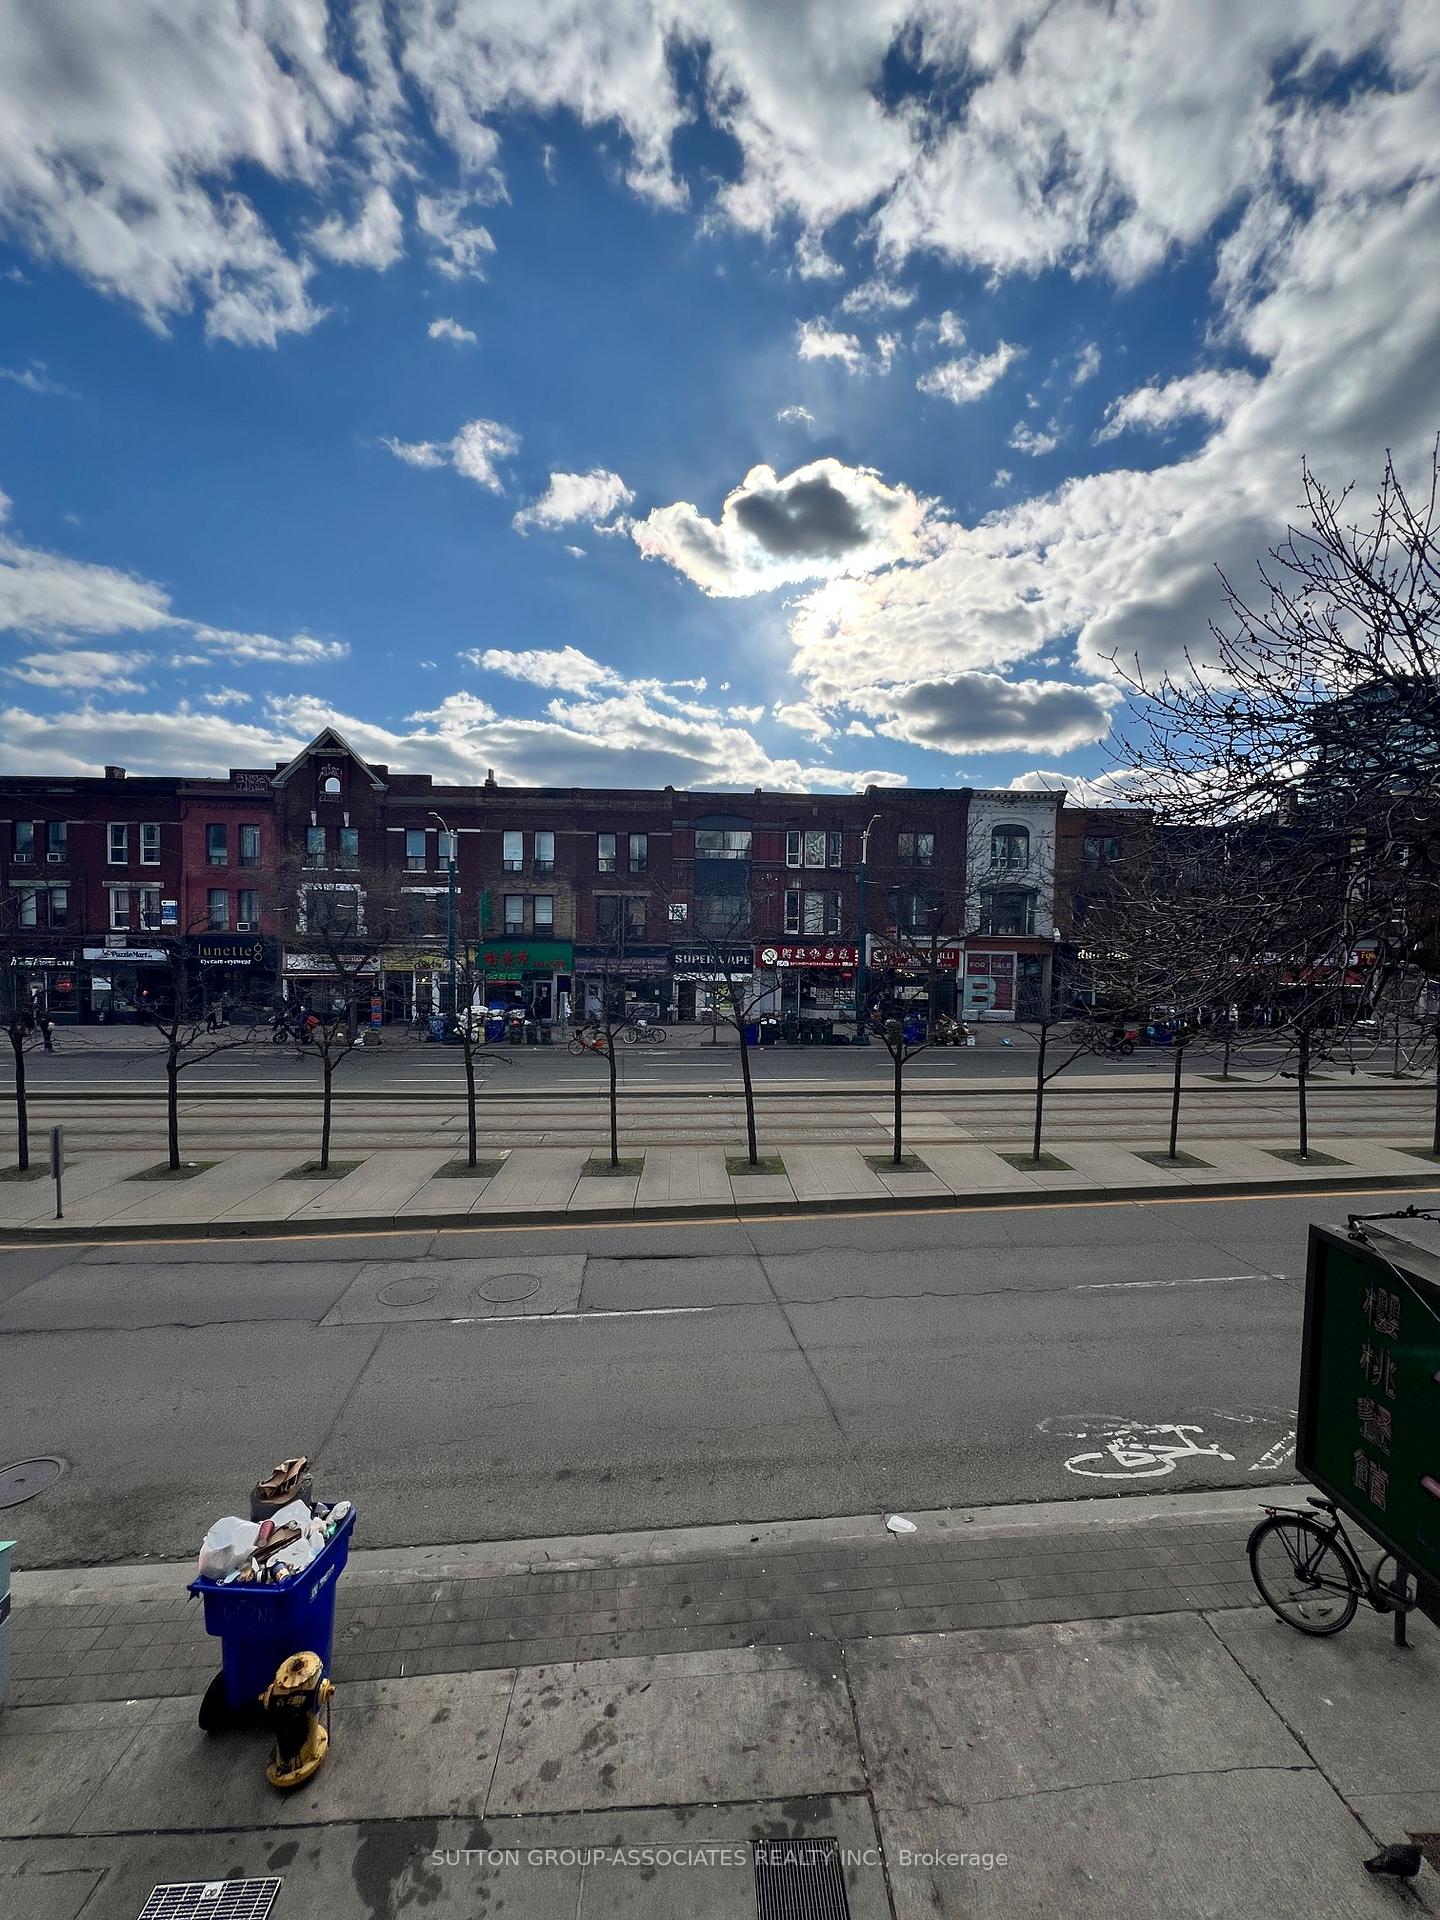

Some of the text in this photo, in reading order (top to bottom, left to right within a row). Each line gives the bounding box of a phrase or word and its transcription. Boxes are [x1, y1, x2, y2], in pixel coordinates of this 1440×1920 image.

[674, 953, 751, 965] SUPER VAPE
[969, 961, 986, 969] FOR
